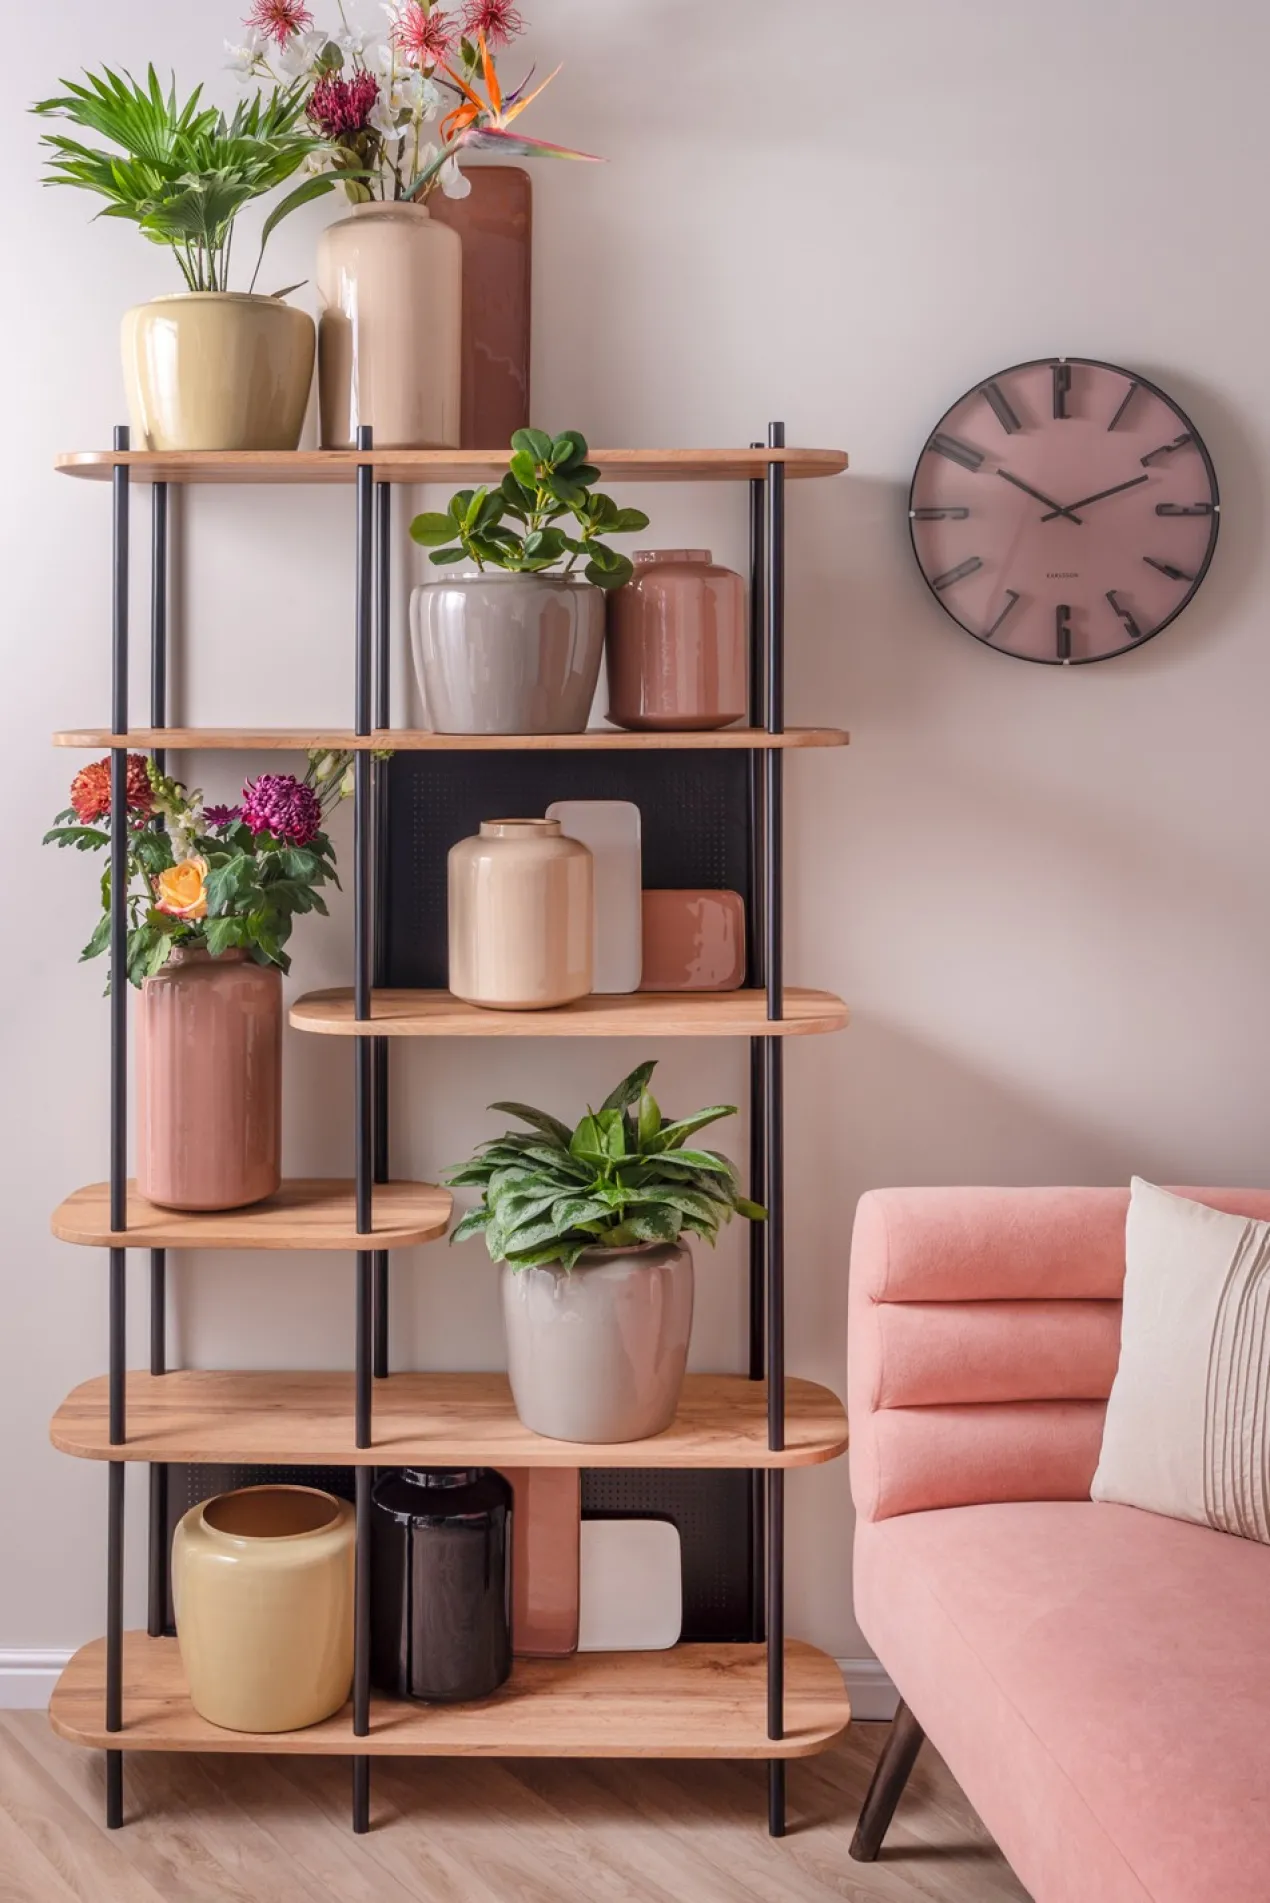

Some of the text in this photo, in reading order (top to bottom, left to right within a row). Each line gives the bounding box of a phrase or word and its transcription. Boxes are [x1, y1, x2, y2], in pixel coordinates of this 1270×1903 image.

[1108, 381, 1138, 432] 1
[1140, 433, 1194, 468] 2
[914, 507, 970, 521] 9
[1155, 503, 1211, 517] 3
[932, 556, 983, 591] 8
[985, 588, 1020, 639] 7
[1056, 604, 1071, 659] 6
[1105, 589, 1142, 638] 5
